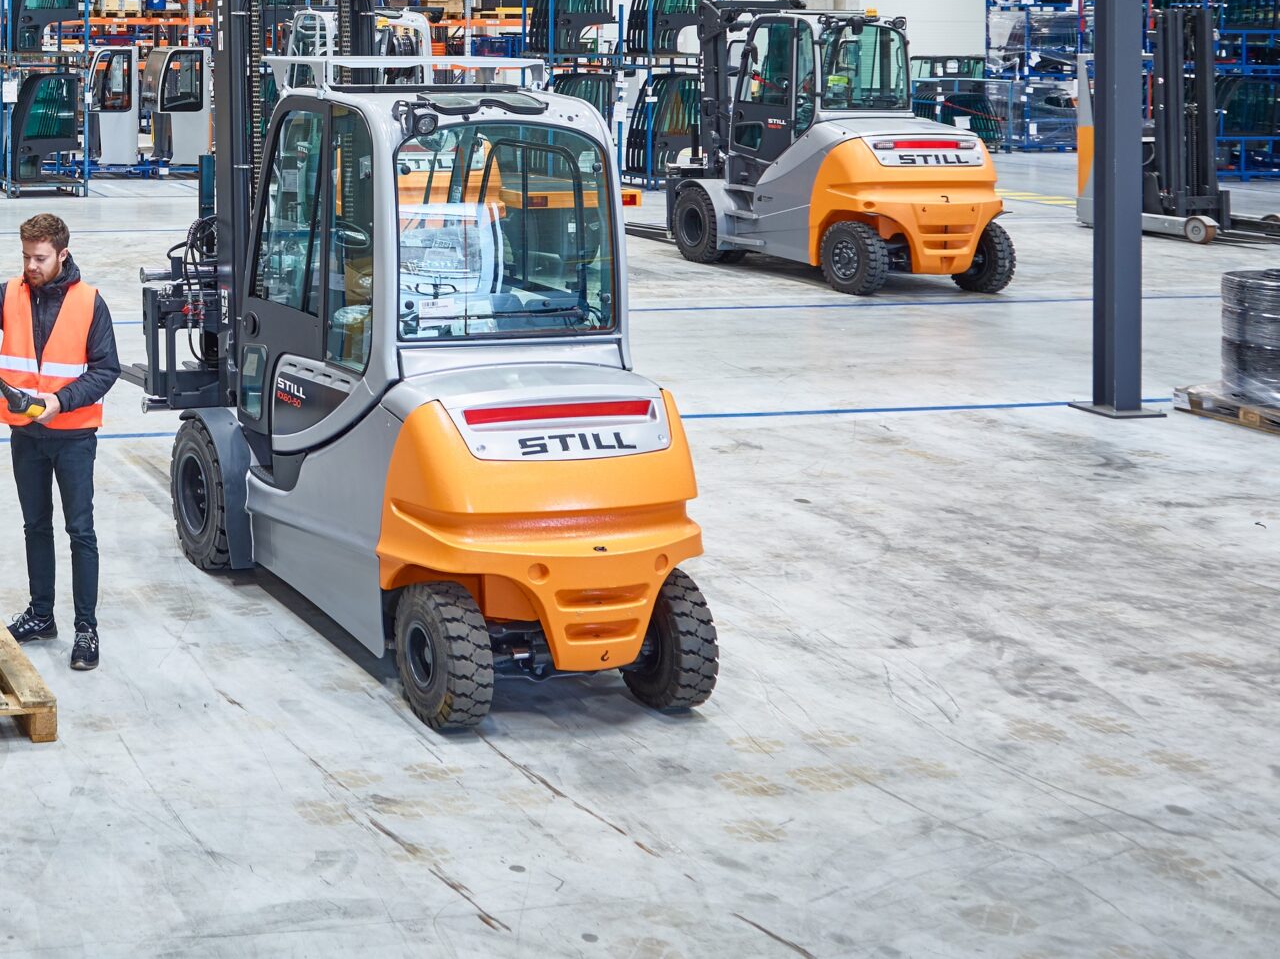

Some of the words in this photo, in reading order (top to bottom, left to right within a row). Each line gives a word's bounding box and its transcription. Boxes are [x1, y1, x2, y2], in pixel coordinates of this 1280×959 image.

[899, 154, 969, 165] STILL
[277, 377, 306, 399] STILL
[518, 432, 637, 456] STILL
